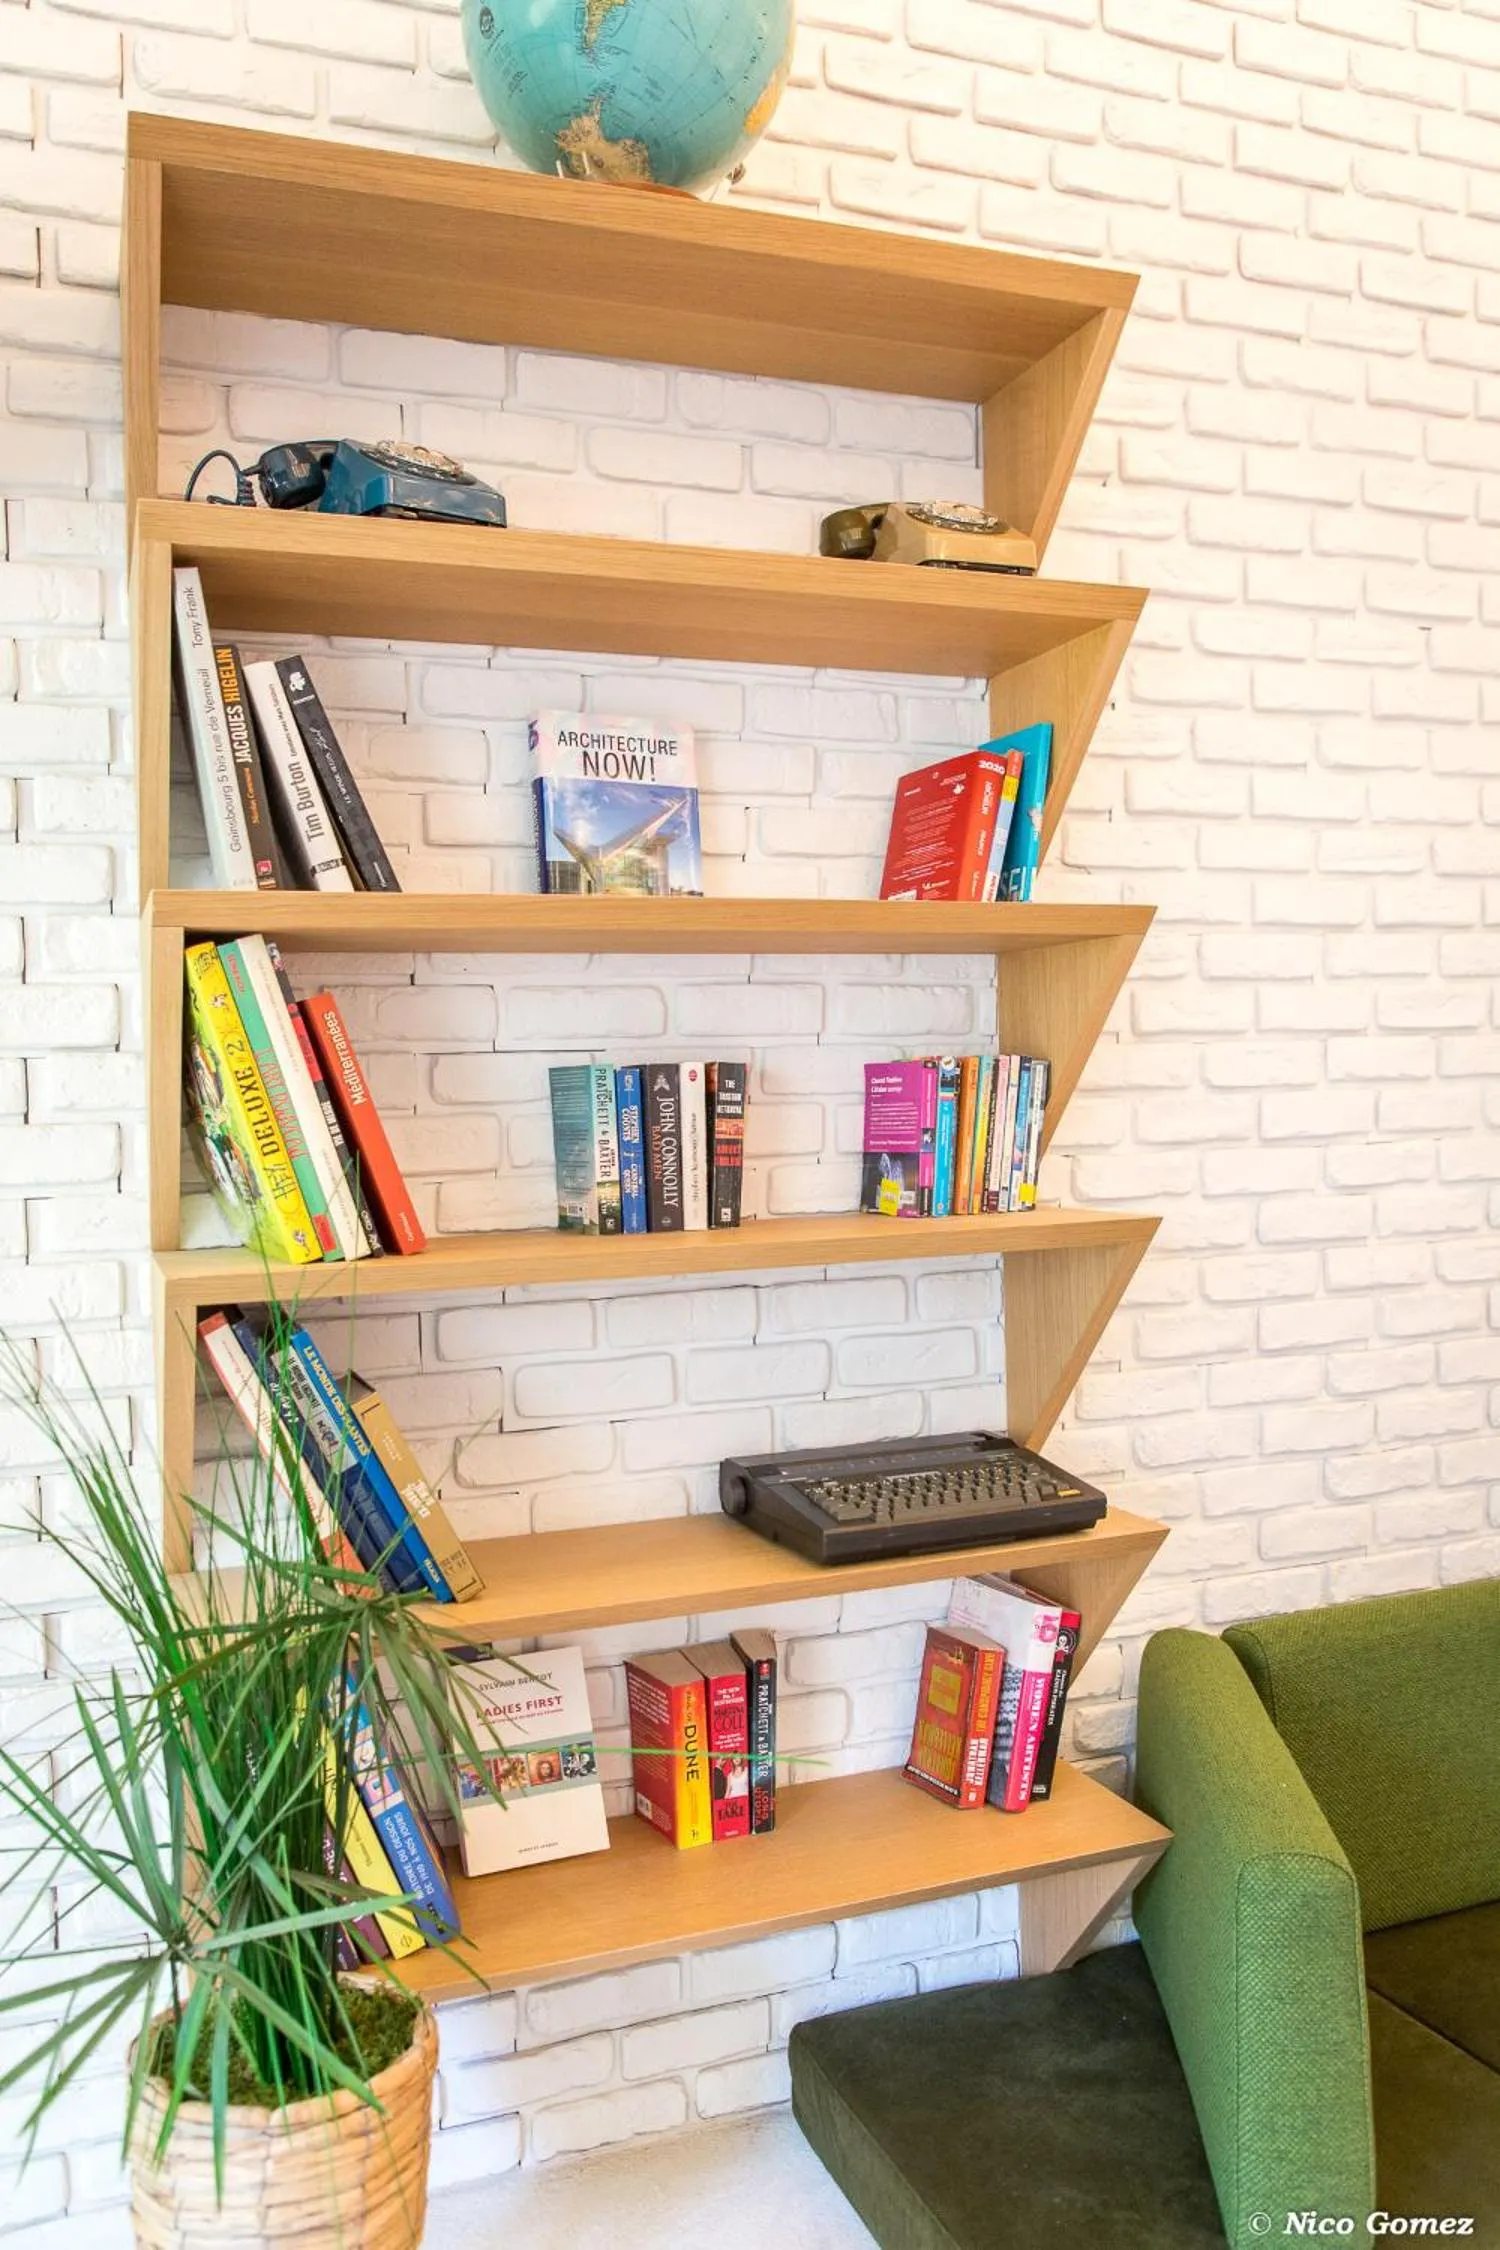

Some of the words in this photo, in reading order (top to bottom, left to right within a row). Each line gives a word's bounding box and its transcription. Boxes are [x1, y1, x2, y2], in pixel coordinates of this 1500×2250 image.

[186, 587, 200, 618] Frank
[192, 619, 204, 649] Tony
[215, 648, 241, 703] HIGELIN
[211, 714, 222, 732] de
[226, 705, 252, 764] JACQUES
[557, 730, 678, 756] ARCHITECTURE
[218, 774, 229, 784] 5
[582, 750, 657, 782] NOW!
[977, 759, 1006, 775] 2020
[288, 761, 315, 813] Burton
[221, 784, 242, 854] Gainsbourg
[305, 815, 325, 843] Tim
[324, 1010, 366, 1106] Méditerranées
[595, 1068, 610, 1126] PRATCHETT
[724, 1079, 735, 1089] THE
[236, 1065, 279, 1157] DELUXE
[656, 1096, 677, 1133] JOHN
[598, 1139, 612, 1178] BAXTER
[654, 1152, 663, 1180] MEN
[661, 1137, 680, 1207] CONNOLLY
[303, 1345, 317, 1360] LE
[311, 1357, 336, 1396] MONDE
[332, 1395, 346, 1415] DES
[526, 1695, 563, 1711] FIRST
[758, 1684, 769, 1734] PRATCHETT
[1028, 1678, 1045, 1731] WOMEN
[684, 1724, 700, 1783] DUNE
[1018, 1733, 1039, 1801] ARTISTS
[384, 1816, 403, 1849] DESIGN
[404, 1837, 418, 1856] NOS
[396, 1848, 408, 1862] DU
